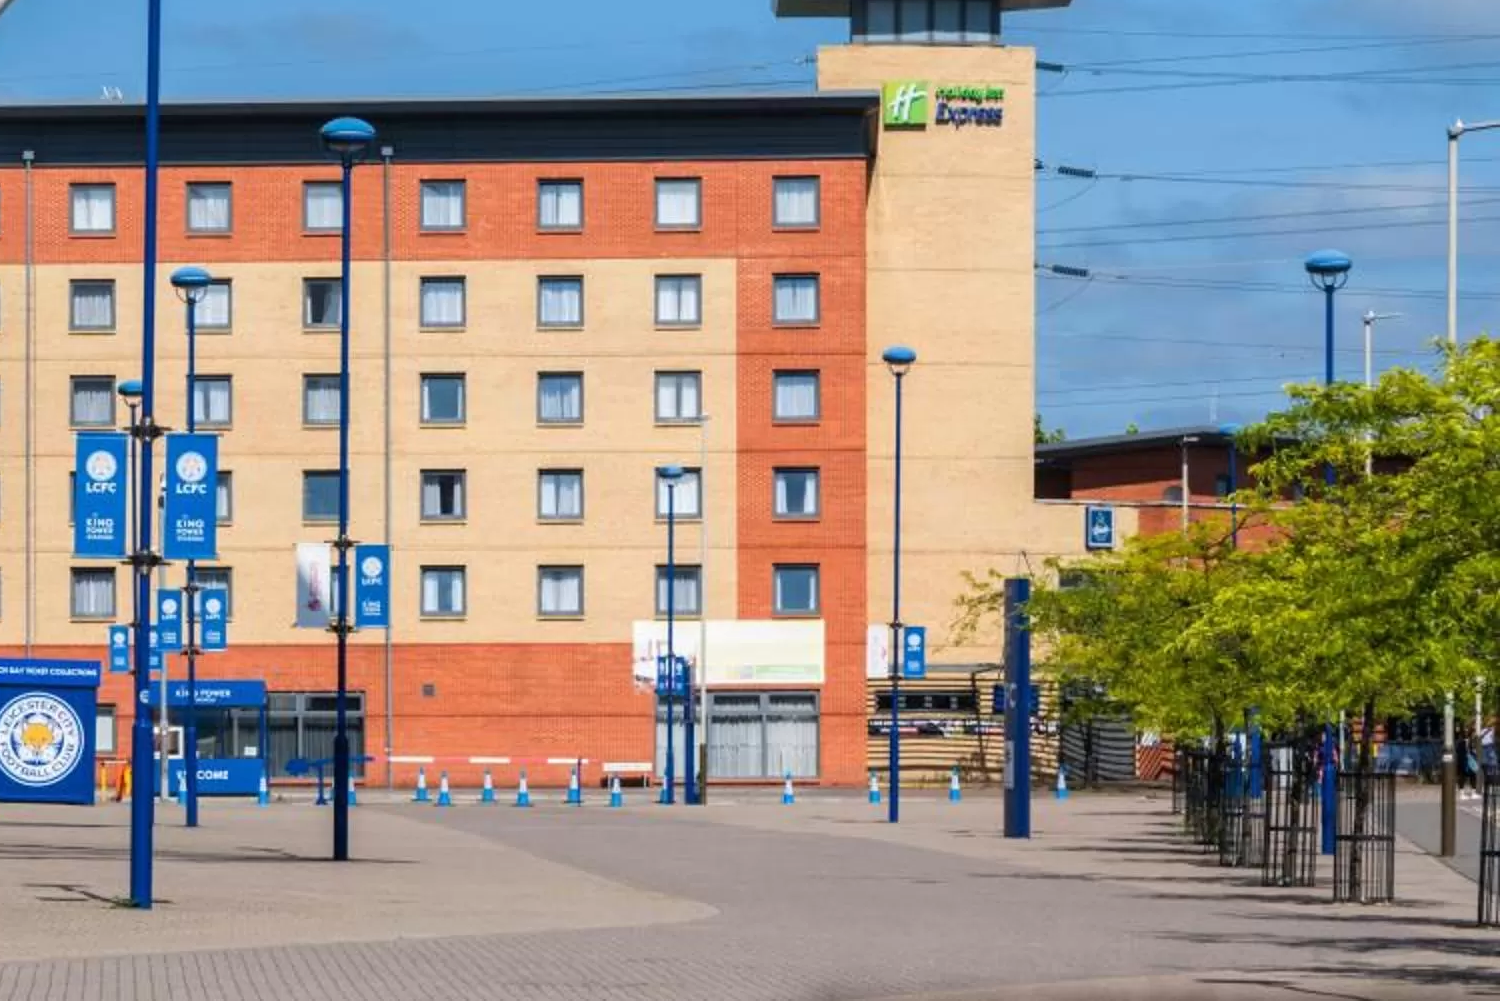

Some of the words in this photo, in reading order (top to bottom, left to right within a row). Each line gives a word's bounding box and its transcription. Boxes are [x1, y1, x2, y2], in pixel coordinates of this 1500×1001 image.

[85, 482, 117, 494] LCFC
[175, 483, 207, 494] LCFC
[86, 518, 114, 527] KING
[176, 519, 205, 528] KING
